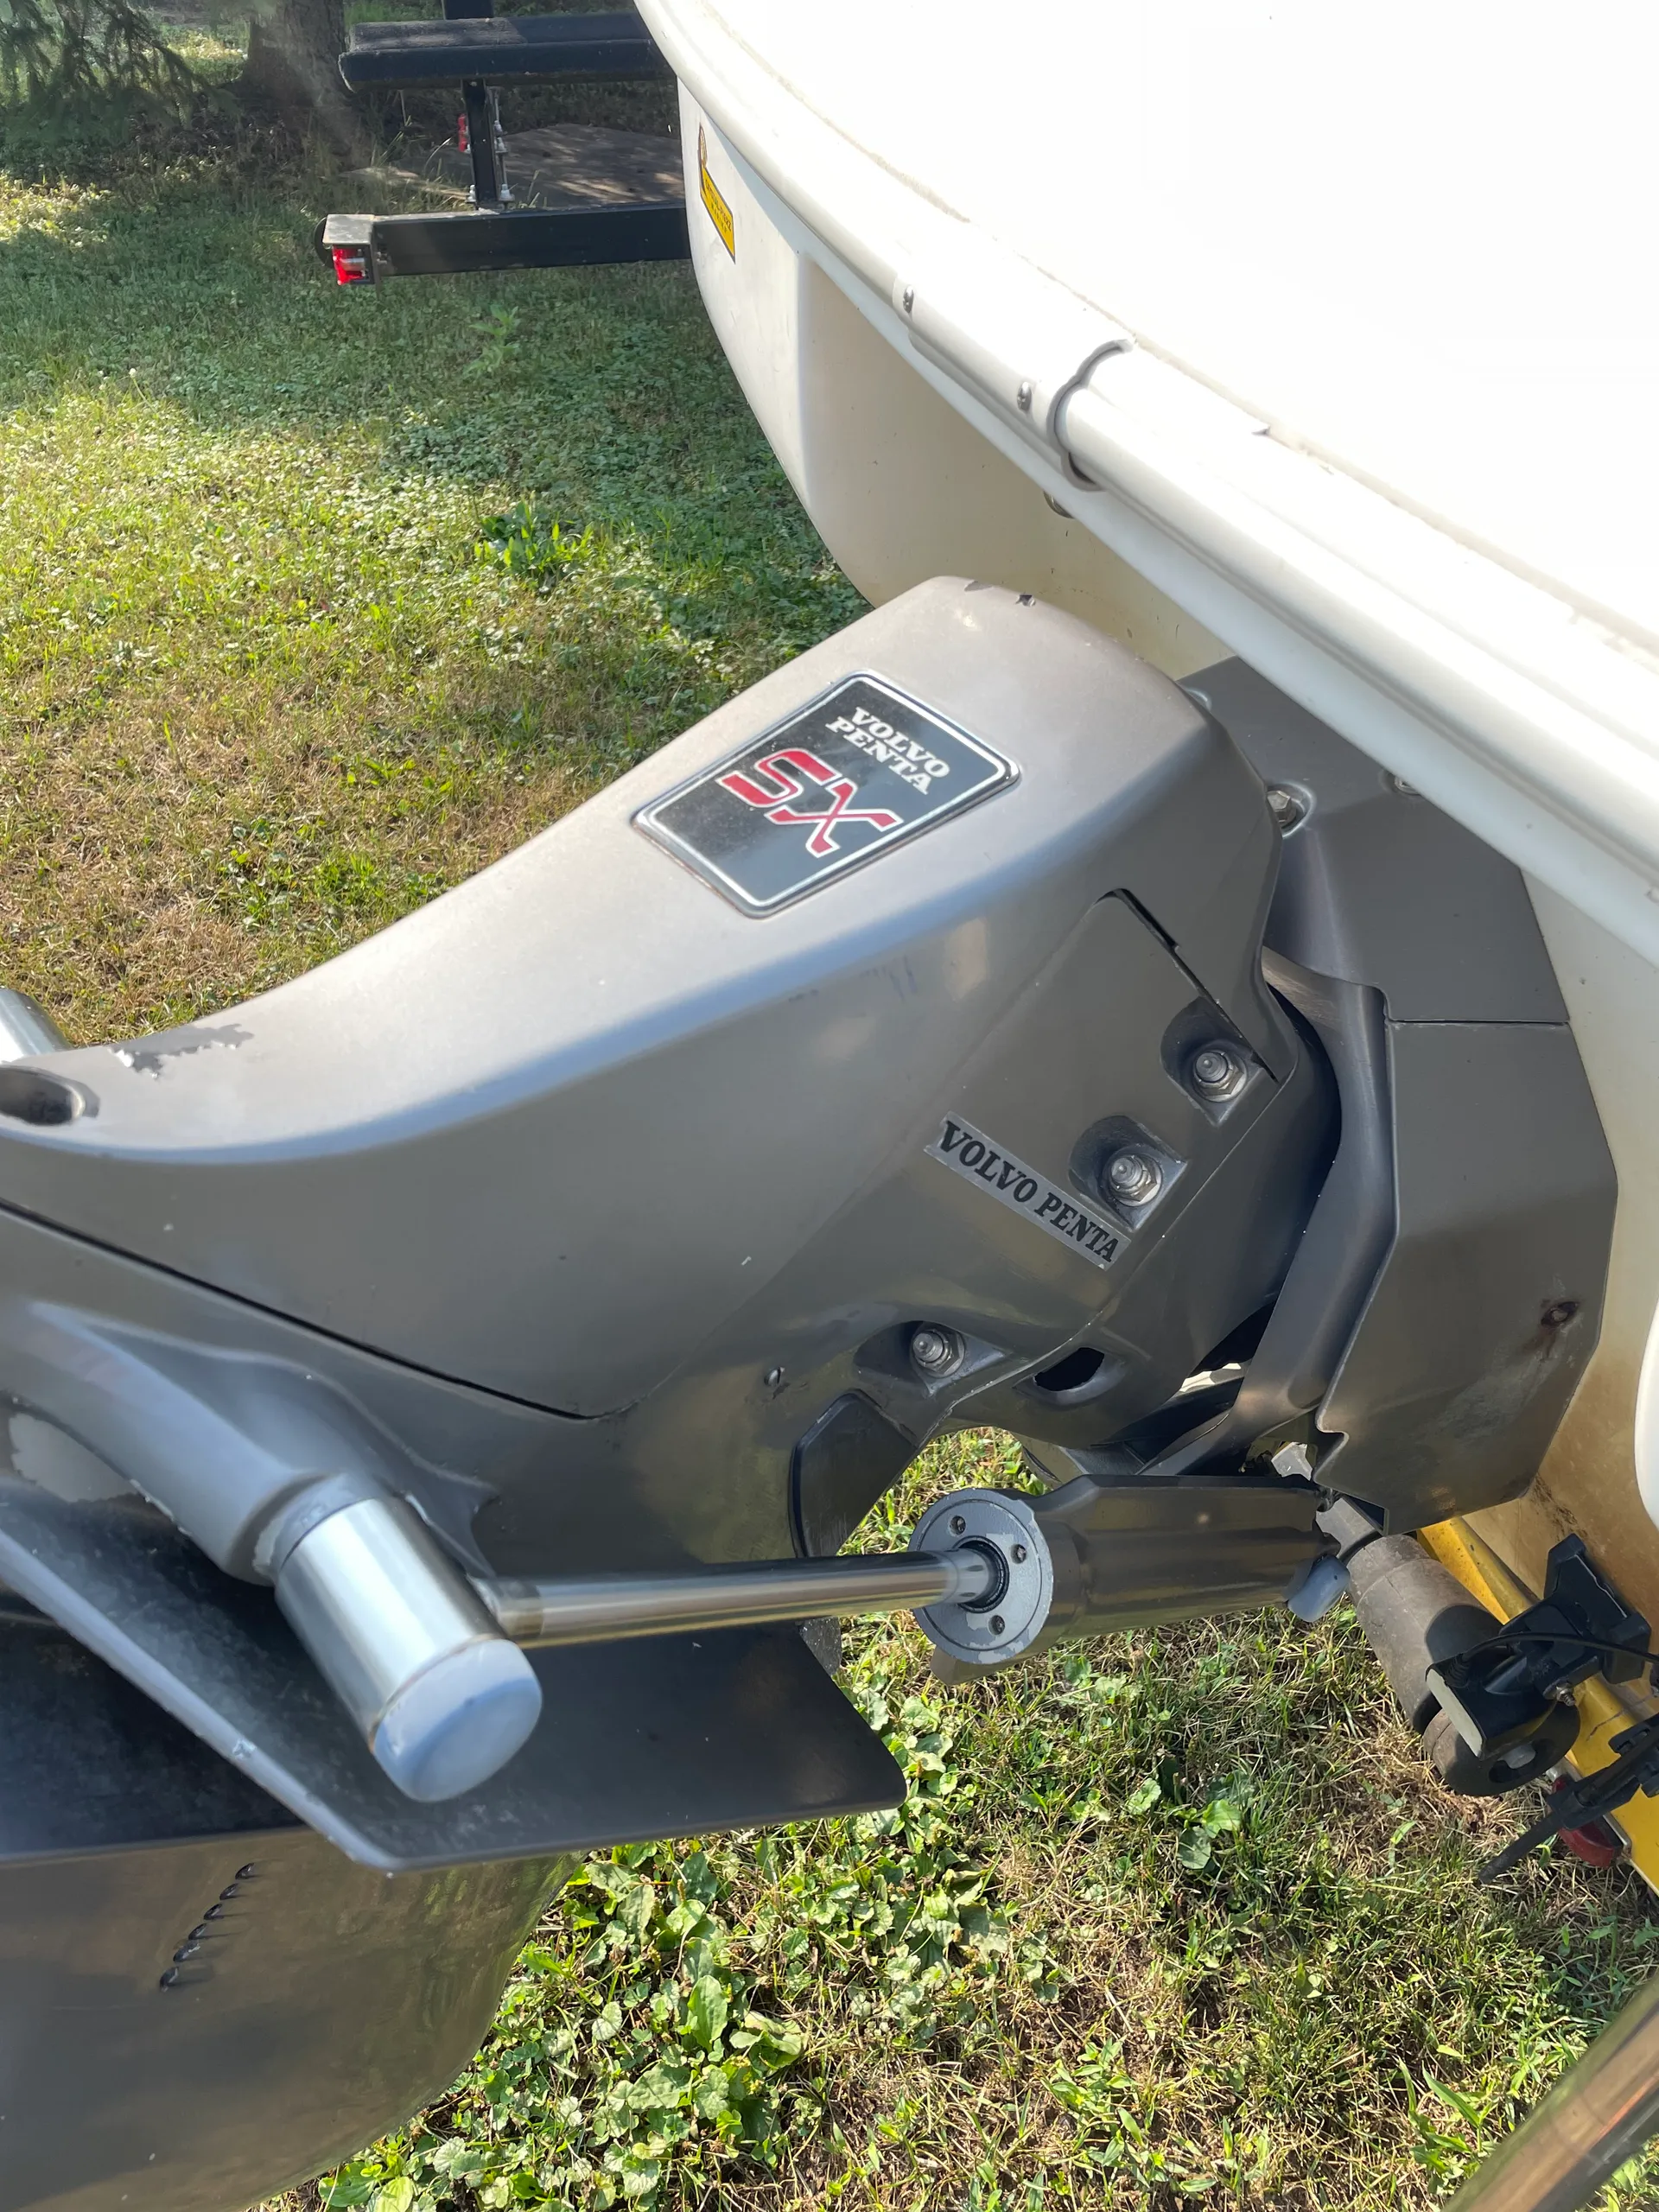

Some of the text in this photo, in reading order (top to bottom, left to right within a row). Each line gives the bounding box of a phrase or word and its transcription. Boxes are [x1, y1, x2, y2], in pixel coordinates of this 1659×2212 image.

[825, 715, 932, 794] PENTA
[852, 707, 950, 779] VOLVO
[716, 748, 903, 858] SX
[938, 1121, 1119, 1262] VOLVO PENTA
